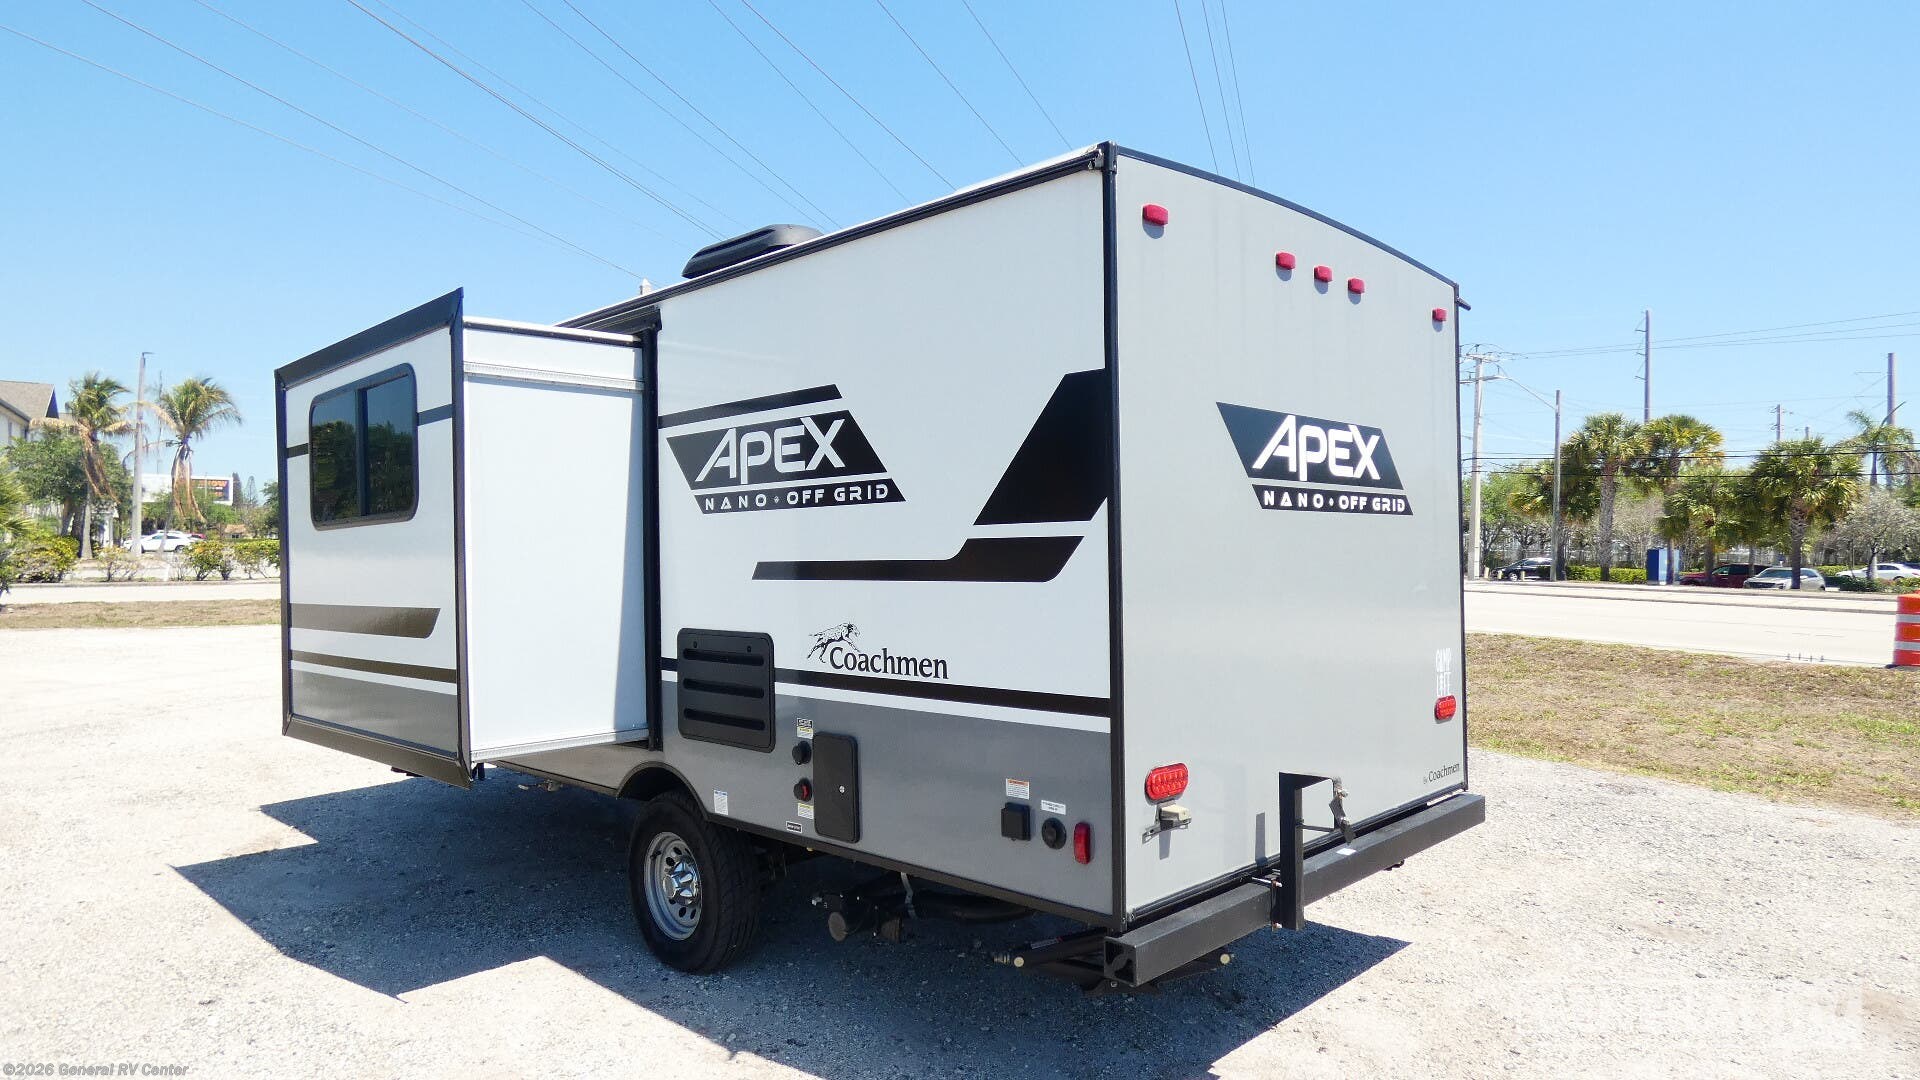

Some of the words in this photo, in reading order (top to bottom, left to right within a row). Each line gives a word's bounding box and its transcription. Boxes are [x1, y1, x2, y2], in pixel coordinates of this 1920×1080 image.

[695, 416, 846, 484] APEX
[1252, 415, 1381, 482] APEX
[705, 492, 767, 511] NANO
[786, 488, 825, 505] OFF
[833, 484, 889, 502] GRID
[1263, 490, 1324, 508] NANO
[1338, 495, 1367, 510] OFF
[1372, 497, 1406, 513] GRID
[829, 646, 949, 679] Coachmen
[1428, 763, 1460, 782] Coachmen
